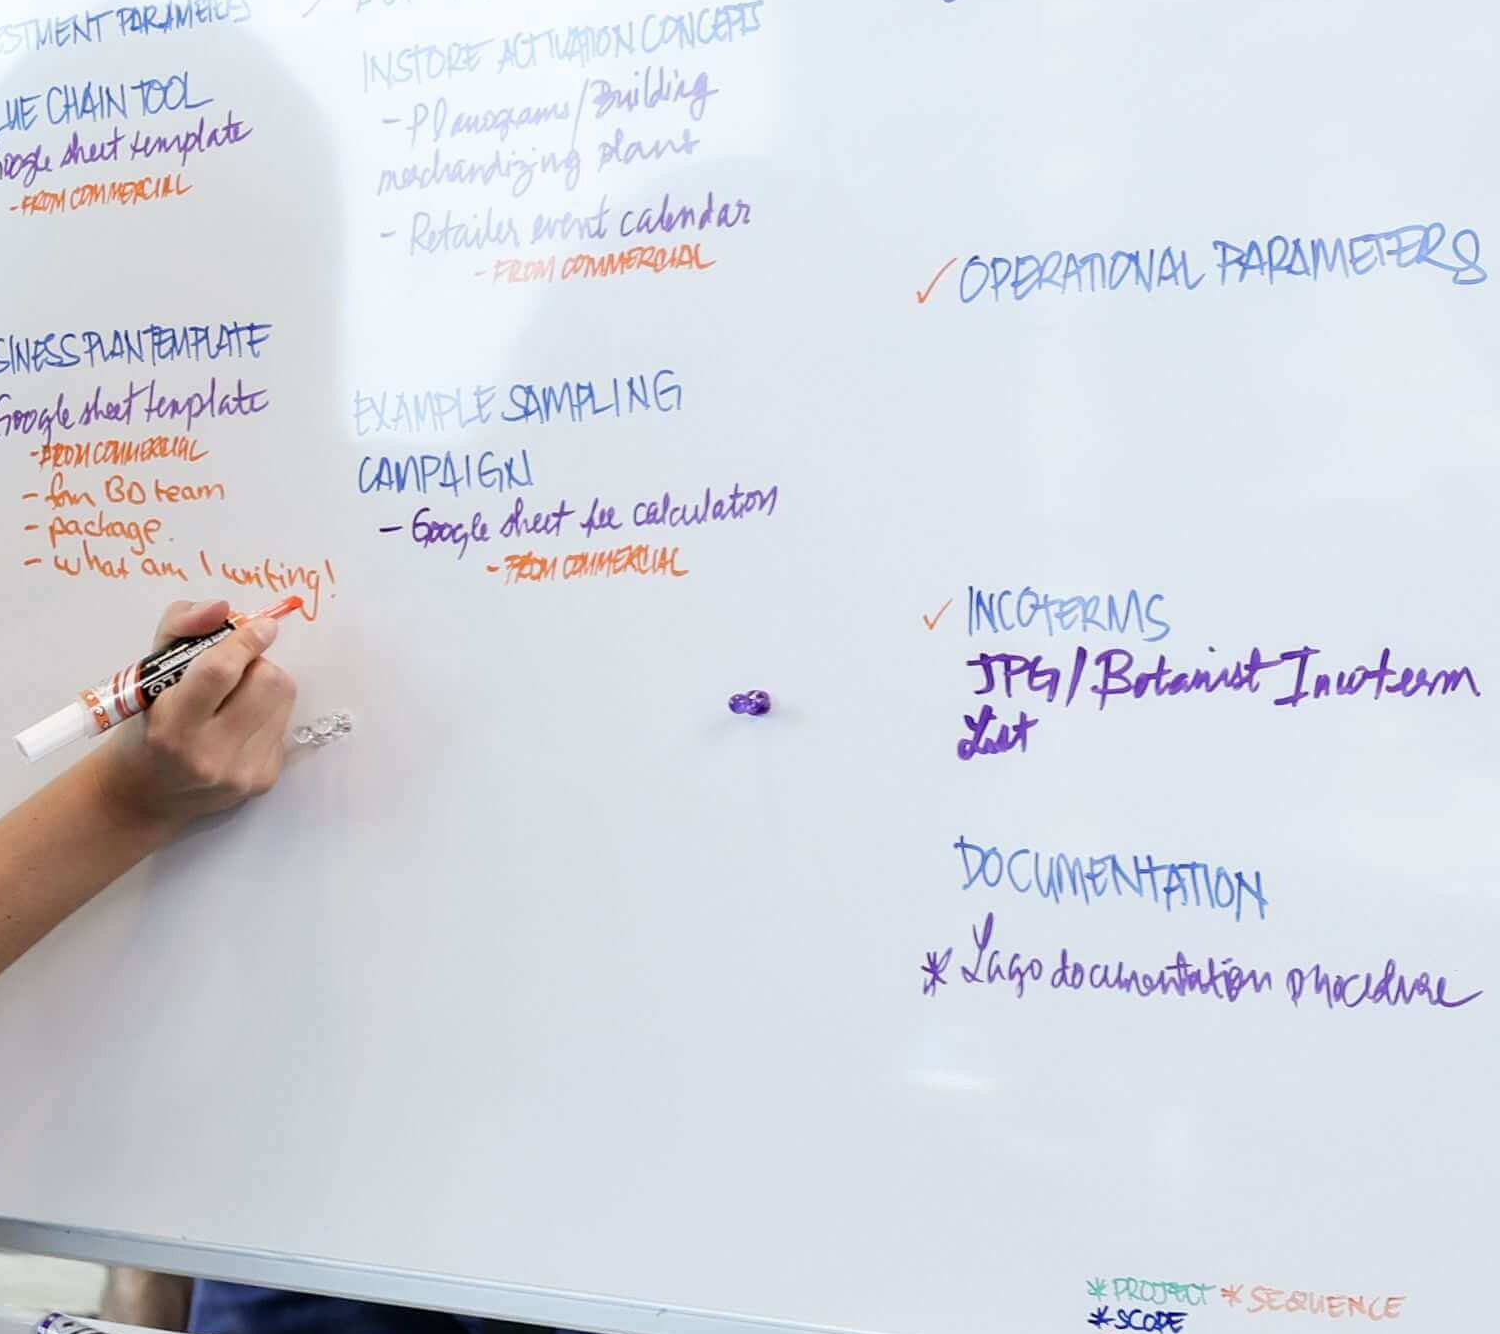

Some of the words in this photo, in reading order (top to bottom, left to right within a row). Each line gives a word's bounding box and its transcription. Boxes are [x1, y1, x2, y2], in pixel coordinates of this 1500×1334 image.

[361, 37, 494, 93] INSTORE
[497, 20, 634, 75] ACTIVATION
[46, 81, 128, 126] CHAIN
[131, 71, 214, 117] TOOL
[61, 126, 126, 166] sheet
[130, 110, 253, 166] template
[21, 188, 66, 216] FROM
[69, 174, 194, 209] COMMERCIAL
[410, 207, 522, 257] Retailer
[531, 195, 613, 244] event
[619, 191, 752, 238] calendar
[492, 254, 555, 285] FROM
[560, 242, 717, 281] COMMERCIAL
[959, 246, 1206, 304] OPERATIONAL
[1212, 222, 1487, 286] PARAMETERS
[82, 330, 144, 369] PLAN
[143, 321, 272, 366] TEMPLATE
[78, 379, 150, 426] sheet
[143, 377, 270, 431] template
[353, 383, 498, 437] EXAMPLE
[501, 368, 683, 425] SAMPLING
[92, 435, 210, 466] COMMERCIAL
[358, 449, 535, 497] CAMPAIGN
[104, 474, 146, 505] BD
[154, 478, 225, 503] team
[411, 508, 490, 559] Google
[499, 497, 576, 541] sheet
[53, 538, 130, 580] what
[141, 557, 189, 582] am
[562, 543, 690, 580] COMMERCIAL
[966, 585, 1172, 643] INCOTERMS
[954, 834, 1269, 922] DOCUMENTATION
[1112, 1277, 1216, 1307] PROJECT
[1247, 1284, 1407, 1323] SEQUENCE
[1113, 1309, 1189, 1334] SCOPE
